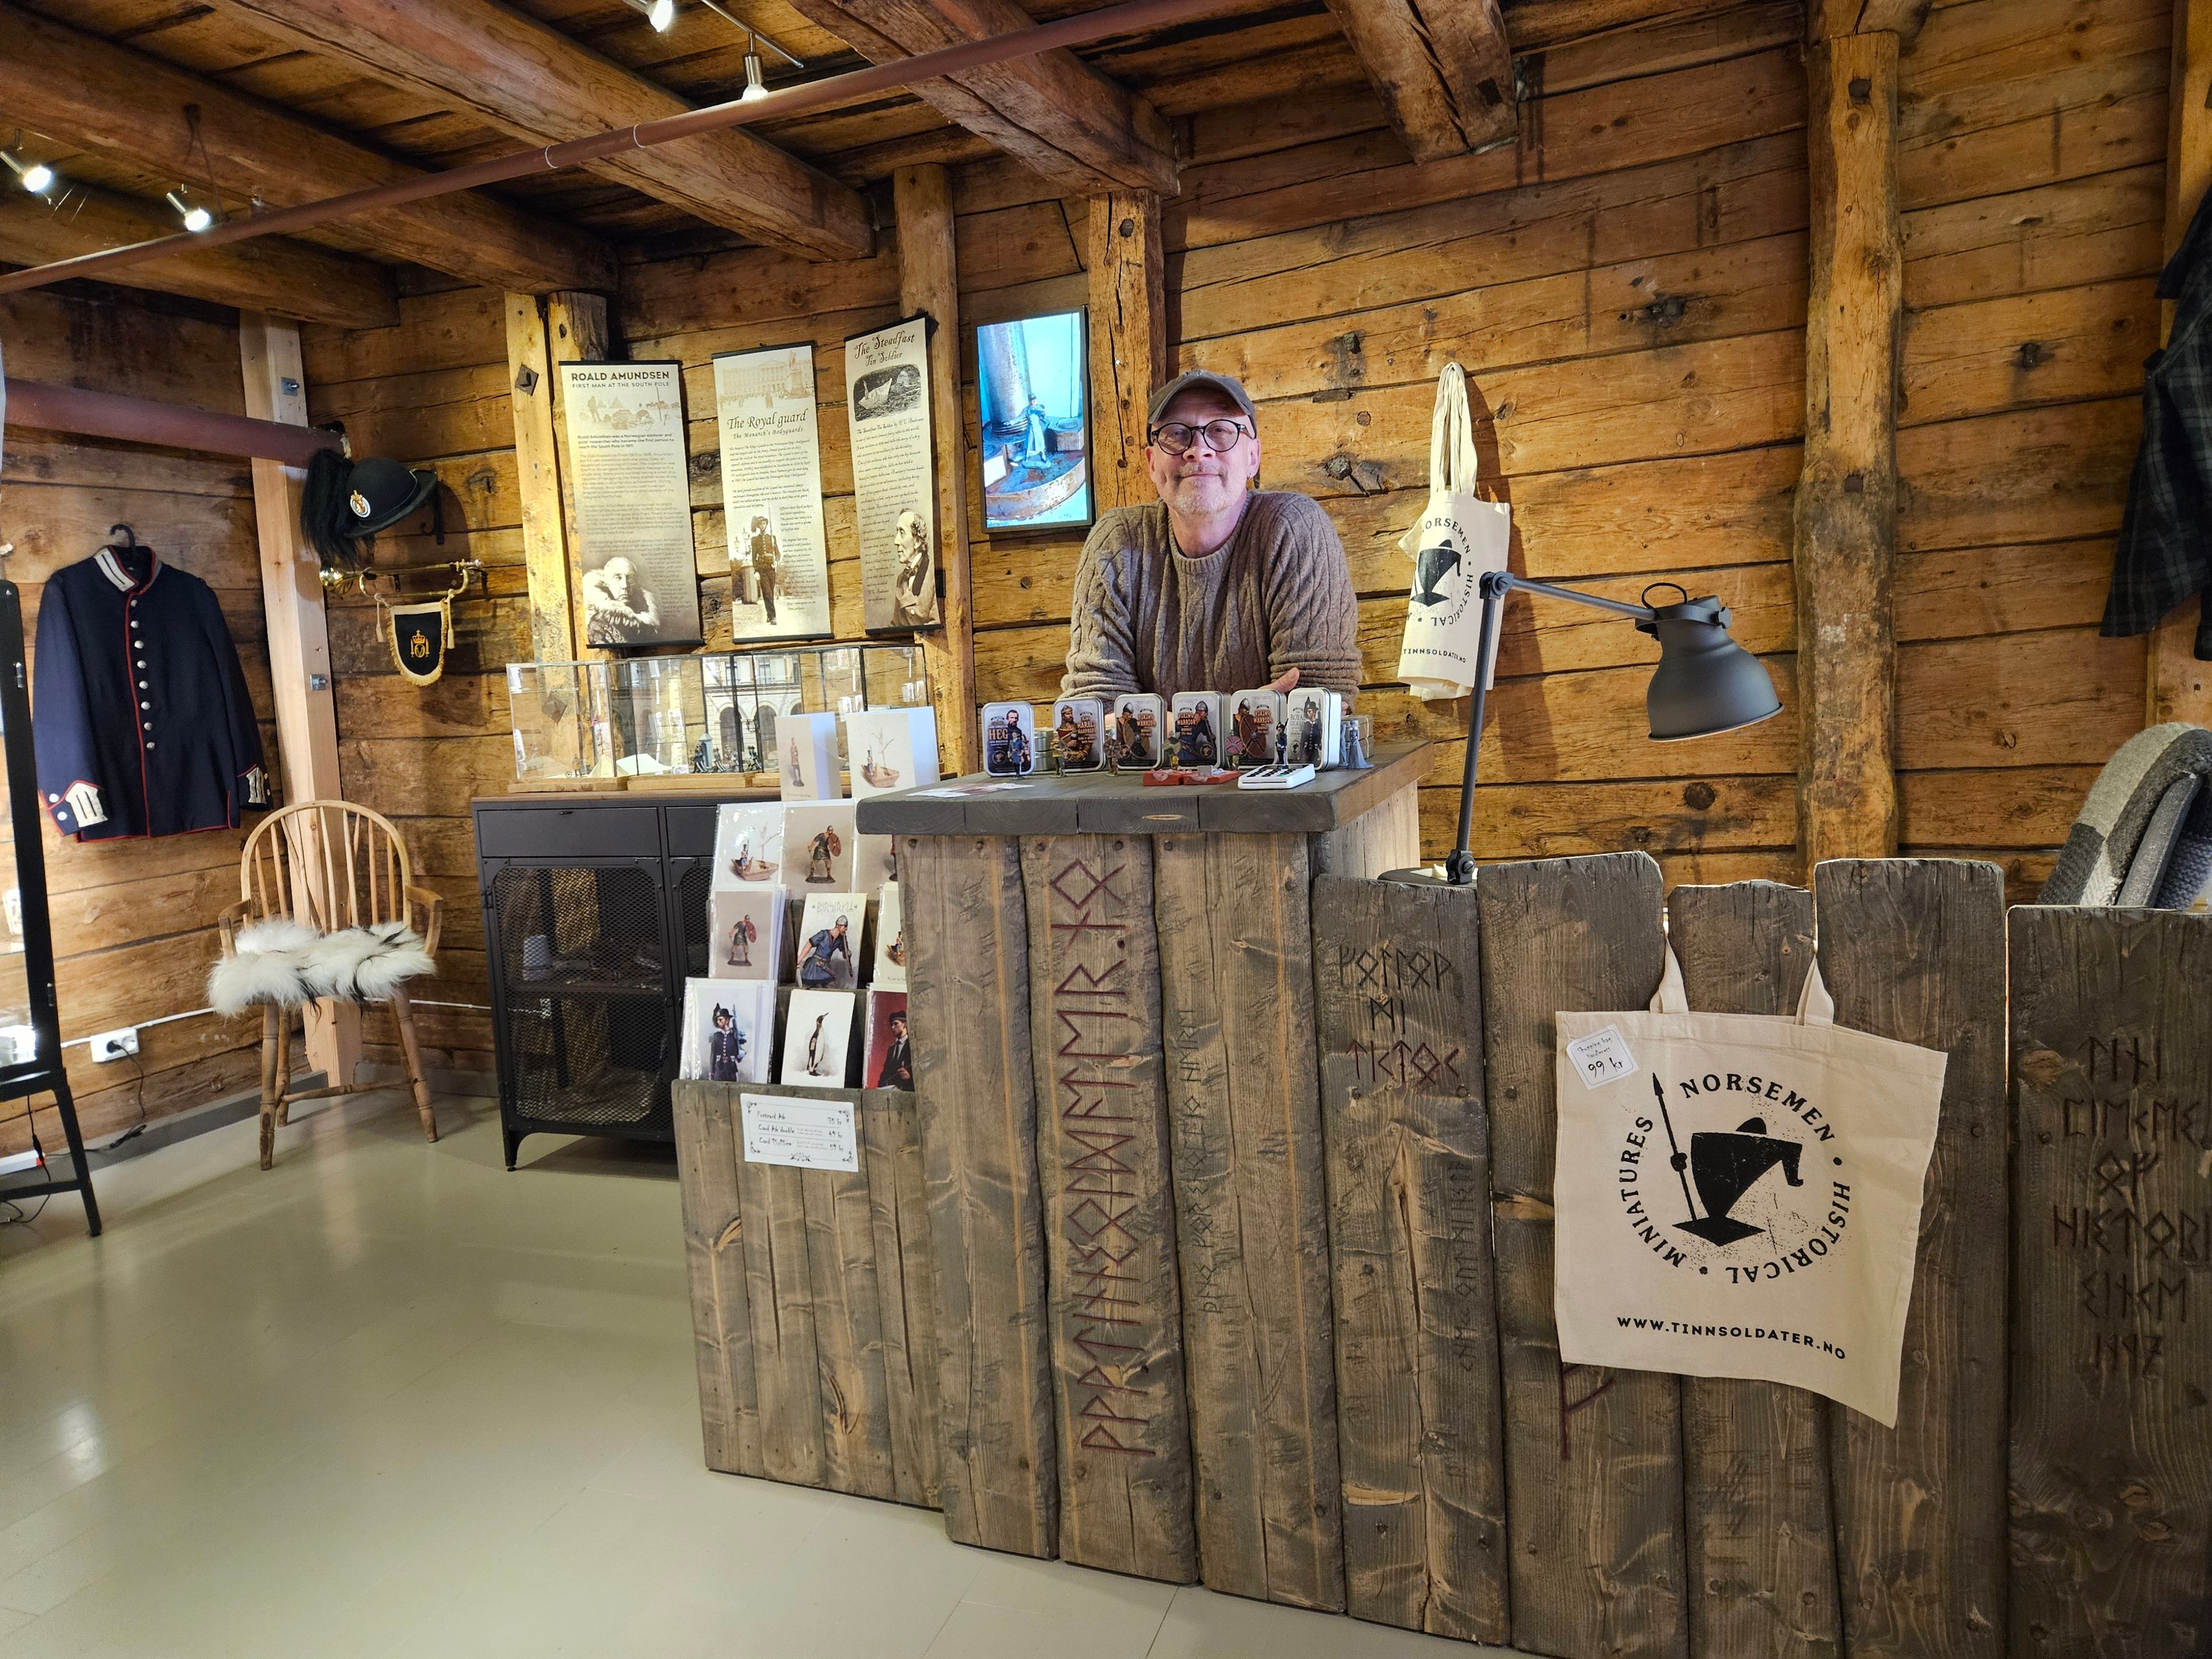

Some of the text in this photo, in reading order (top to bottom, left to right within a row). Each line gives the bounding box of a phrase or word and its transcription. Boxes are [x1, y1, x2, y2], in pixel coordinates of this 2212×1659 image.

[854, 330, 915, 359] The Steadfast
[865, 351, 902, 366] Tin Soldier
[571, 371, 670, 381] ROALD AMUNDSEN
[727, 408, 808, 430] The Royal guard
[773, 426, 803, 435] Bodyguards
[1422, 518, 1471, 554] ORSEMEN
[1430, 574, 1473, 627] HISTORICAL
[988, 728, 1008, 740] HEG
[1577, 1042, 1601, 1053] Shopping
[1588, 1057, 1623, 1078] 99 kr
[1679, 1073, 1835, 1142] NORSEMEN
[1618, 1116, 1687, 1268] MINIATURES
[1725, 1182, 1851, 1284] HISTORICAL
[1617, 1316, 1847, 1360] WWW.TINNSOLDATER.NO
